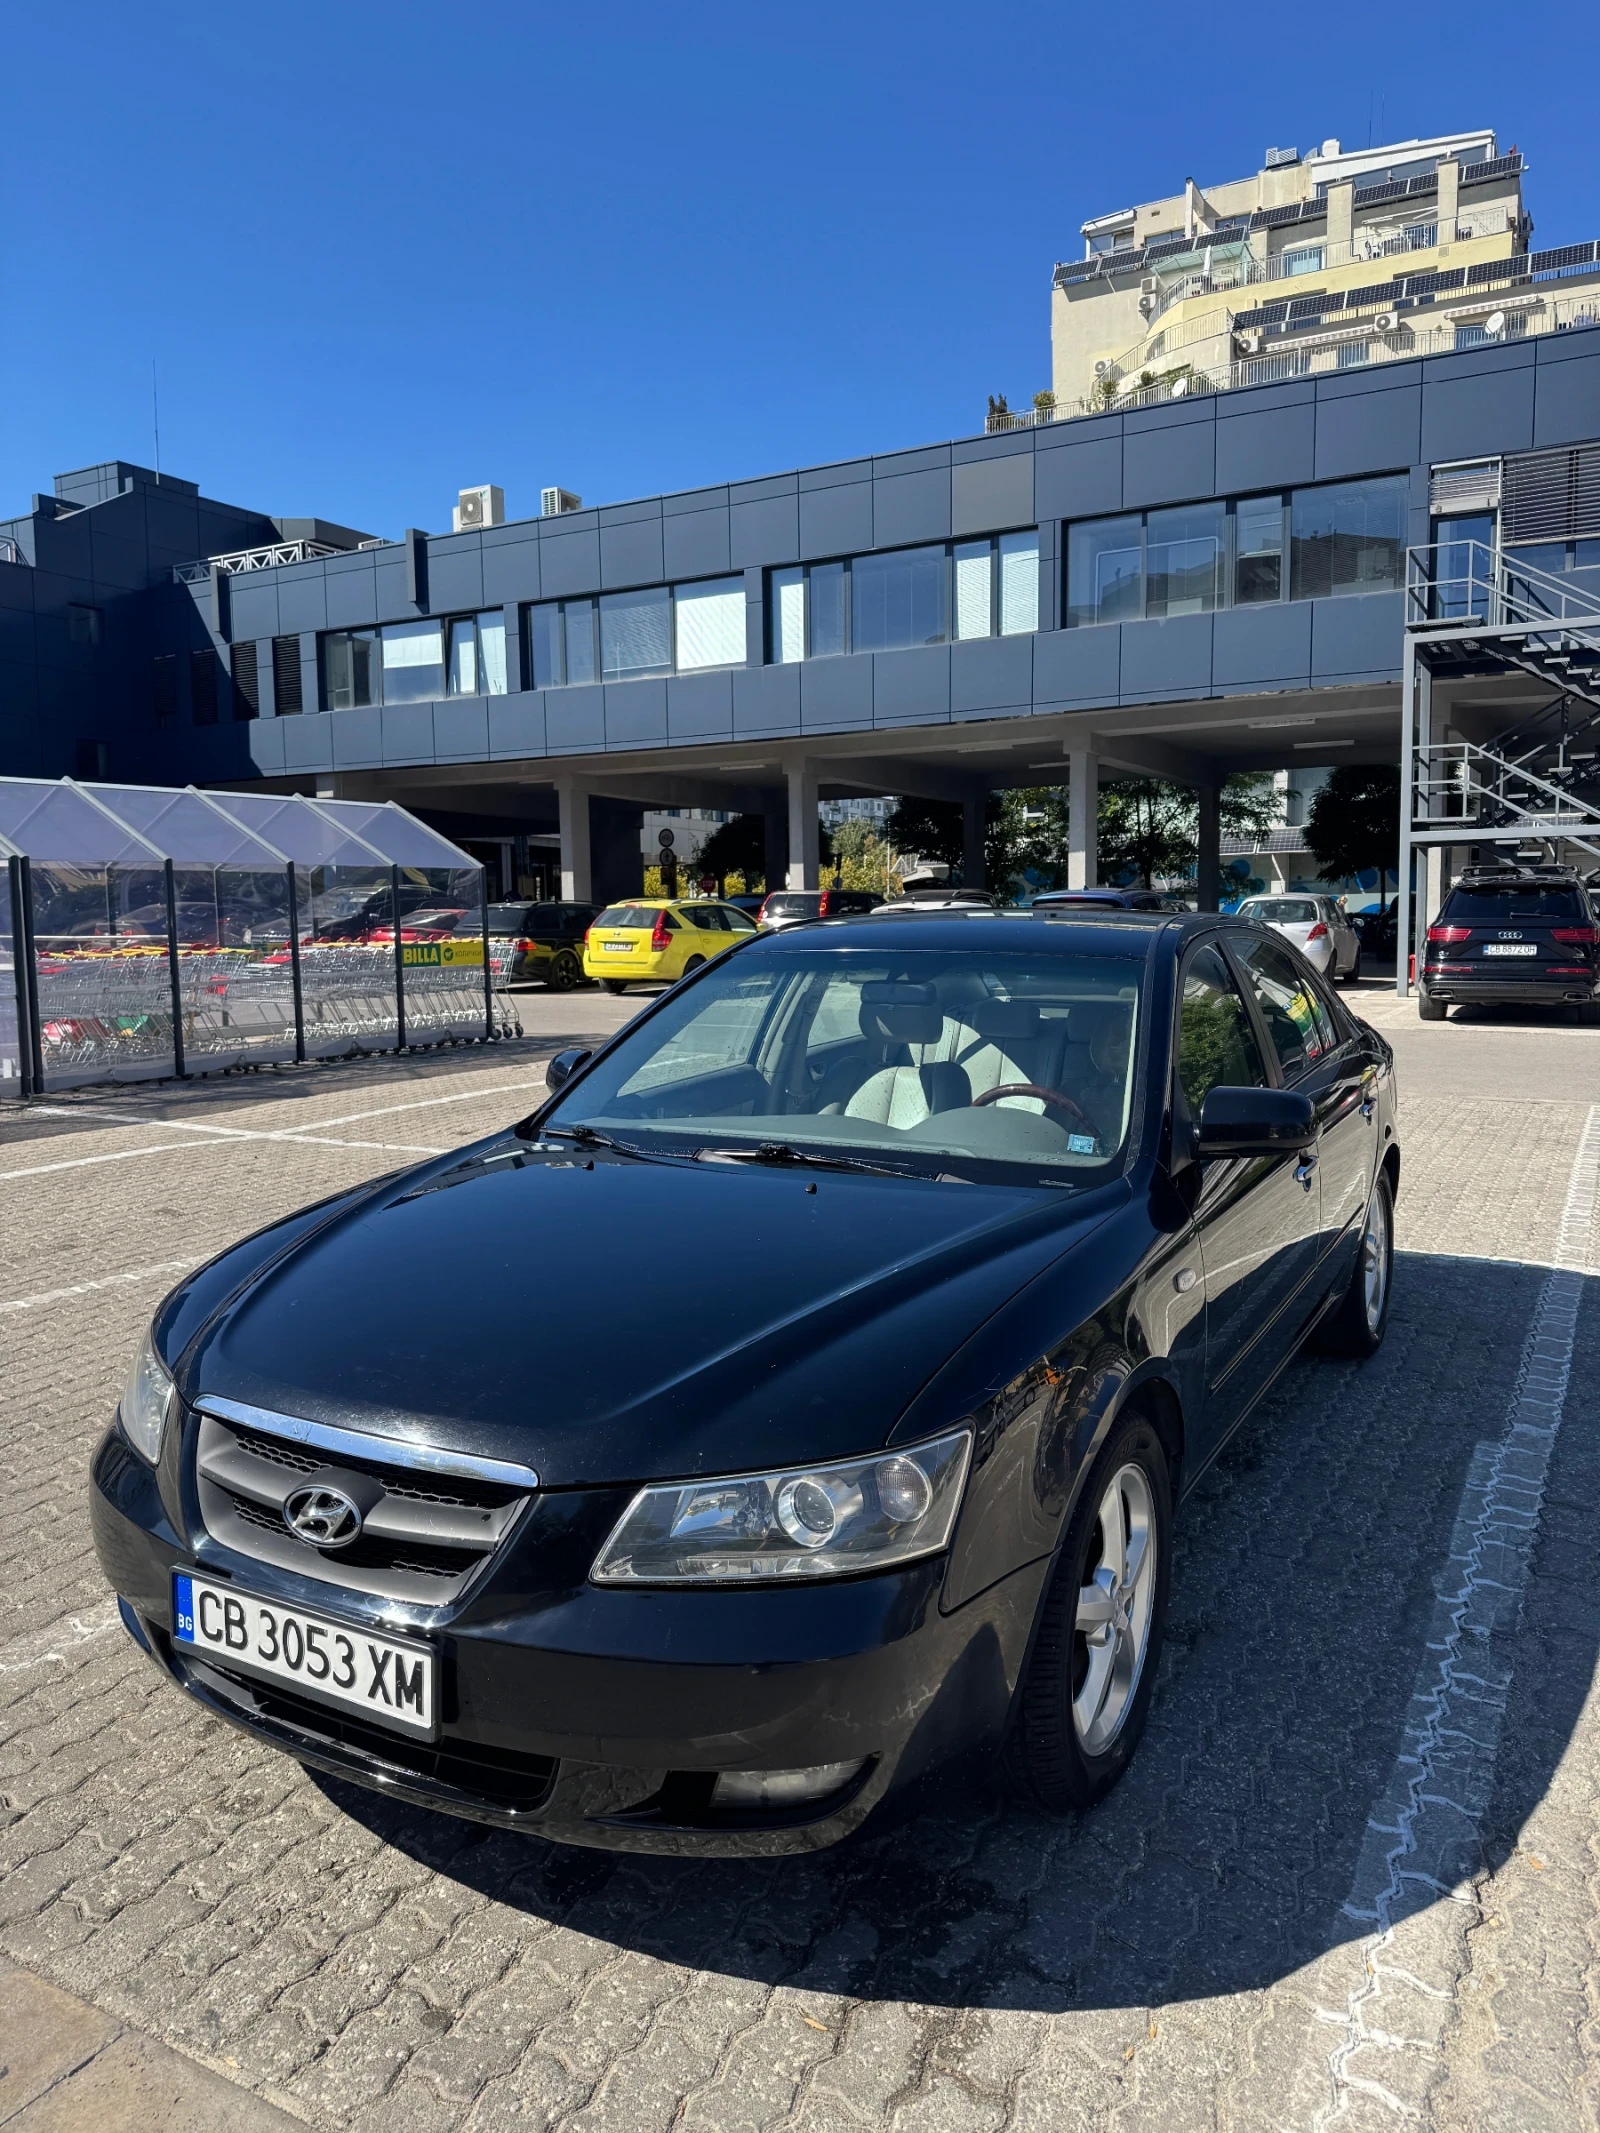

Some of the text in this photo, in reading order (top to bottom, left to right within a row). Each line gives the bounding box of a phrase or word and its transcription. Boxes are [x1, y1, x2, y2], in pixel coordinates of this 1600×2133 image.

[403, 947, 439, 964] BILLA
[177, 1589, 425, 1717] BG CB 3053 XM
